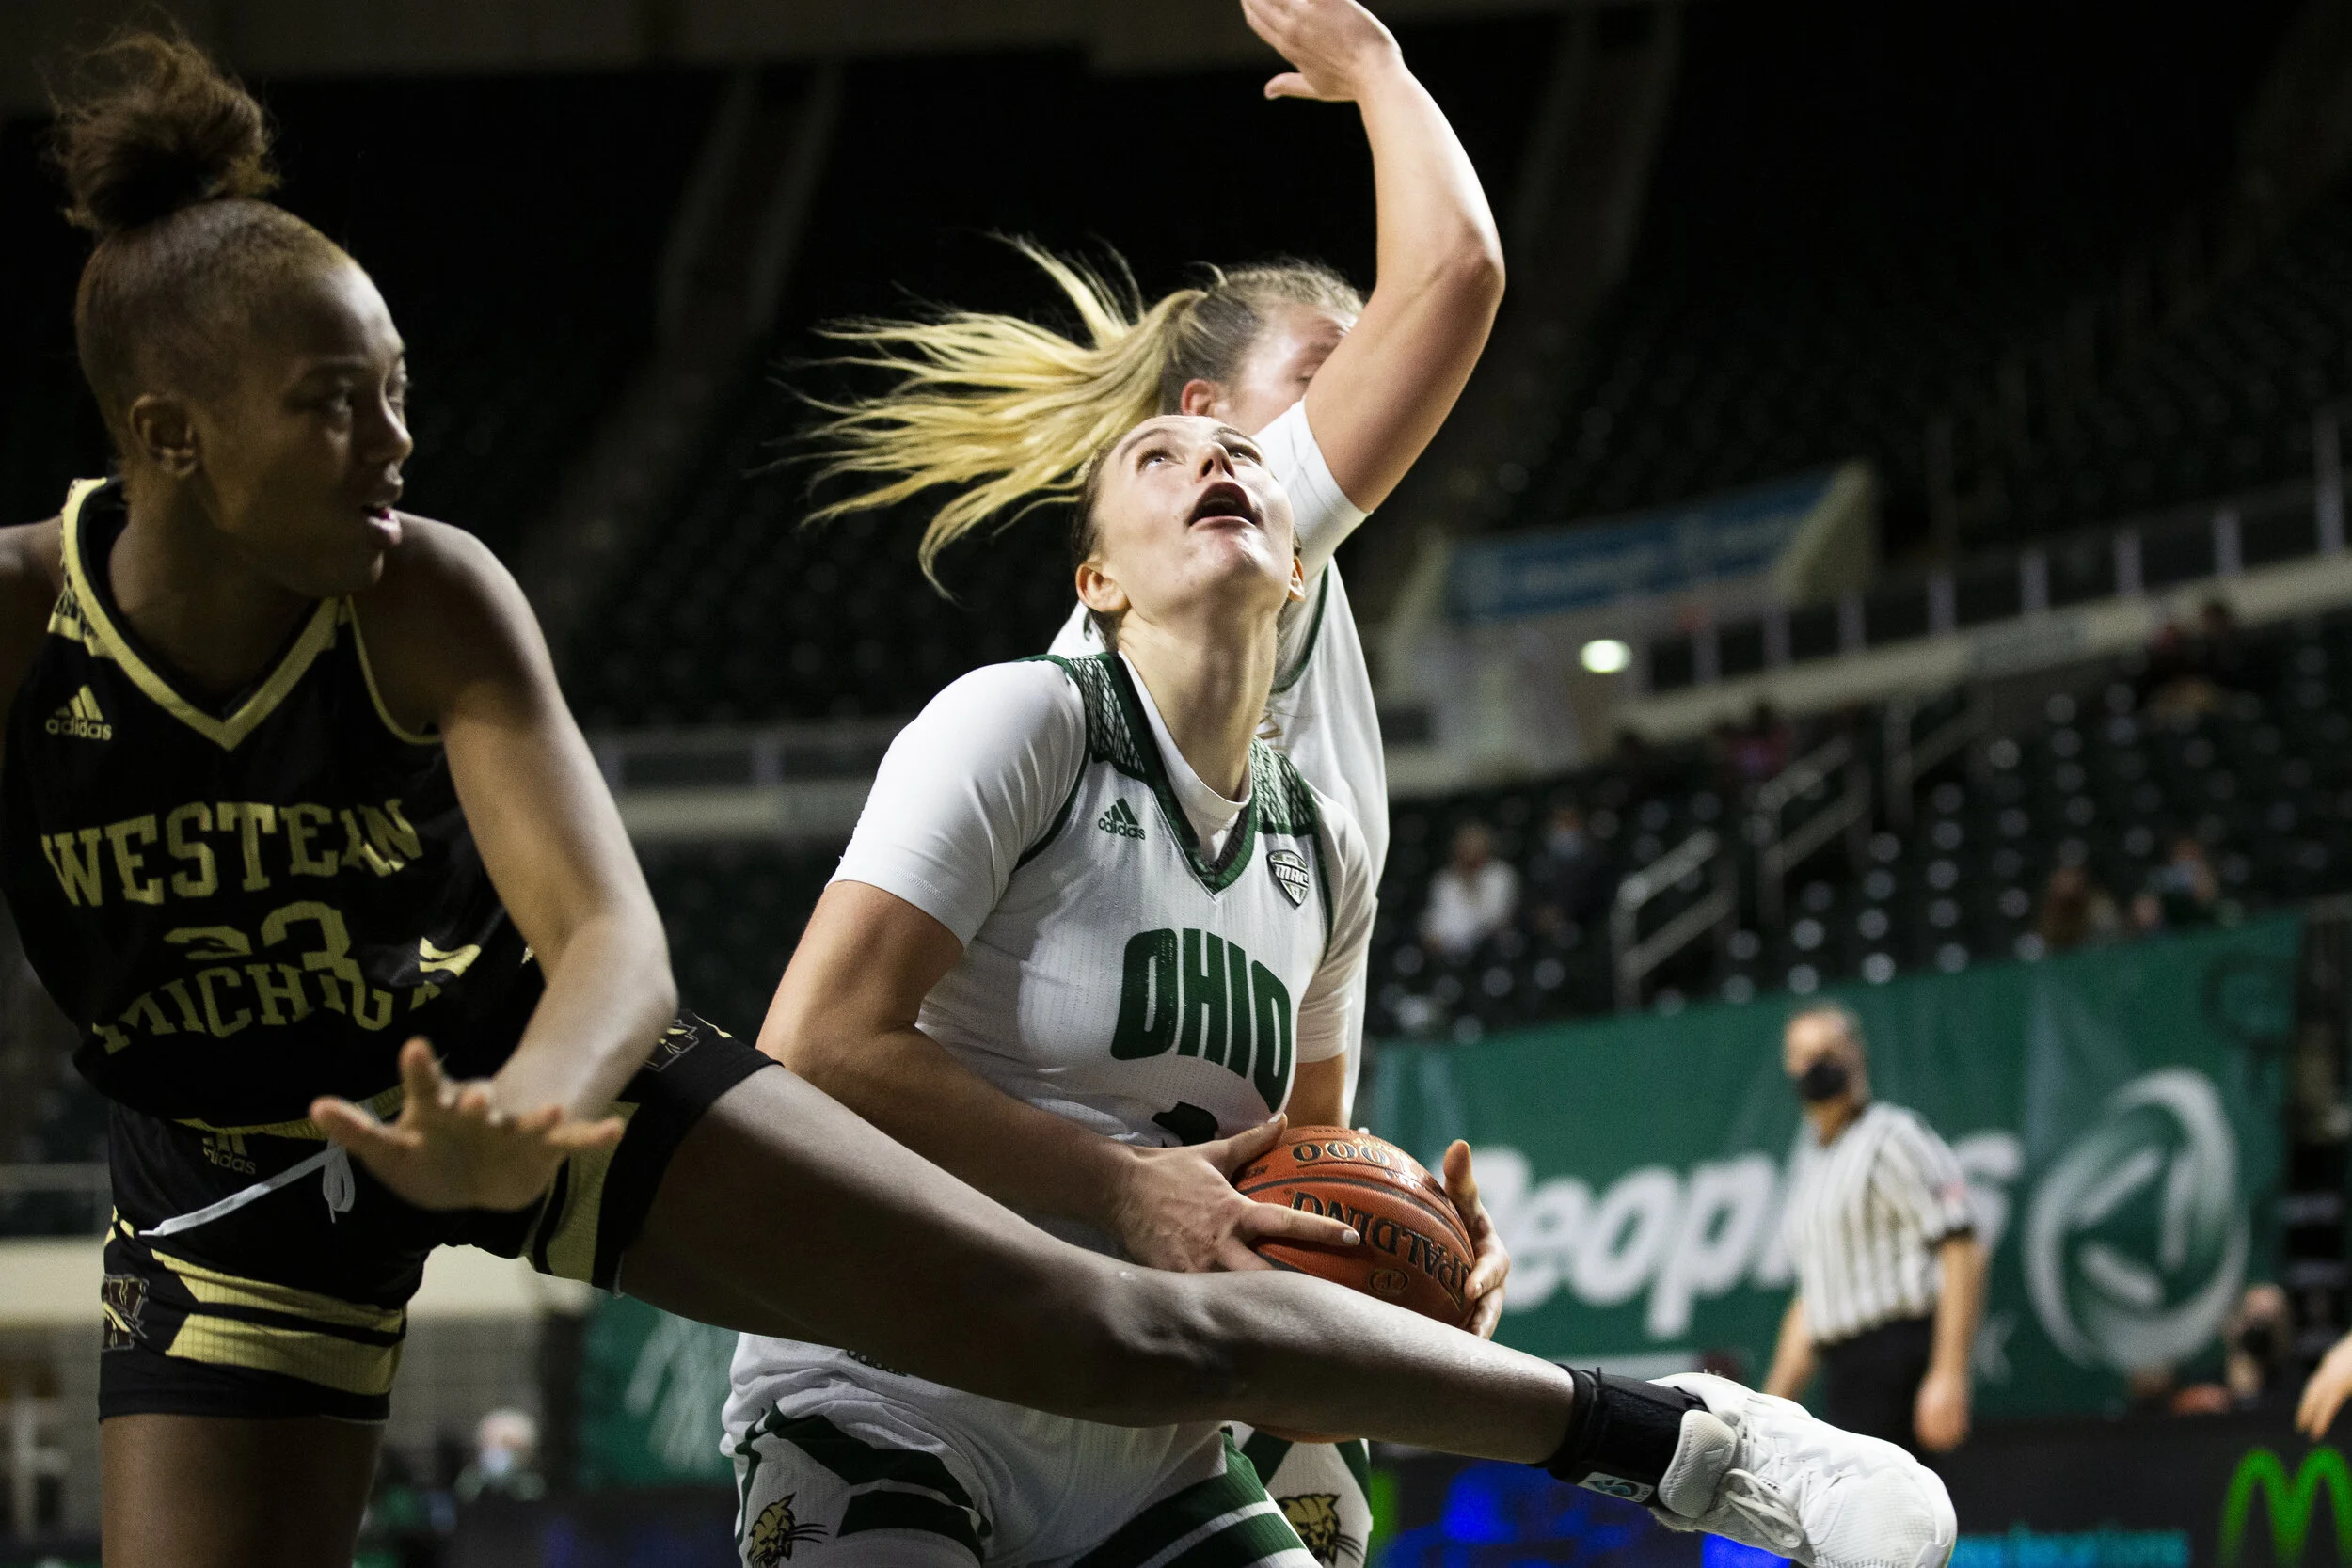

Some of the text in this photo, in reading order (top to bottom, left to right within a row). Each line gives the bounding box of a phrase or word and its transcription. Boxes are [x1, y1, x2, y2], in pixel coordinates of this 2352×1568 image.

[45, 717, 113, 741] adidas
[1098, 817, 1146, 840] adidas
[1274, 863, 1310, 888] MAC
[1110, 927, 1292, 1115] OHIO
